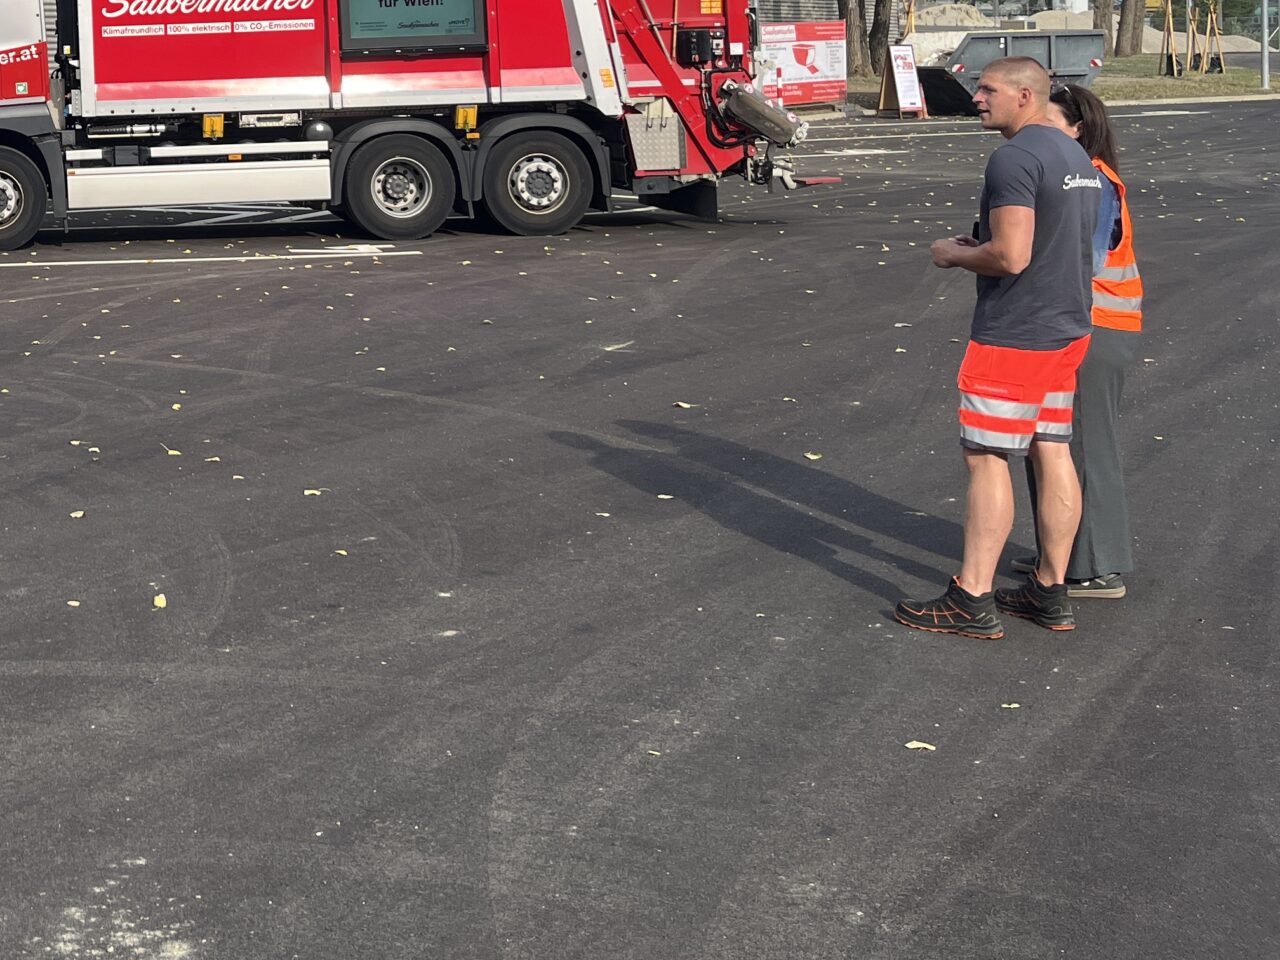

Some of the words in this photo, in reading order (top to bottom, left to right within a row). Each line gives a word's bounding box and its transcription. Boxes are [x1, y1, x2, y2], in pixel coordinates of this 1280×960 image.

[102, 26, 164, 35] Klimafreundlich
[168, 24, 190, 33] 100%
[191, 22, 231, 32] elektrisch
[234, 22, 248, 31] 0%
